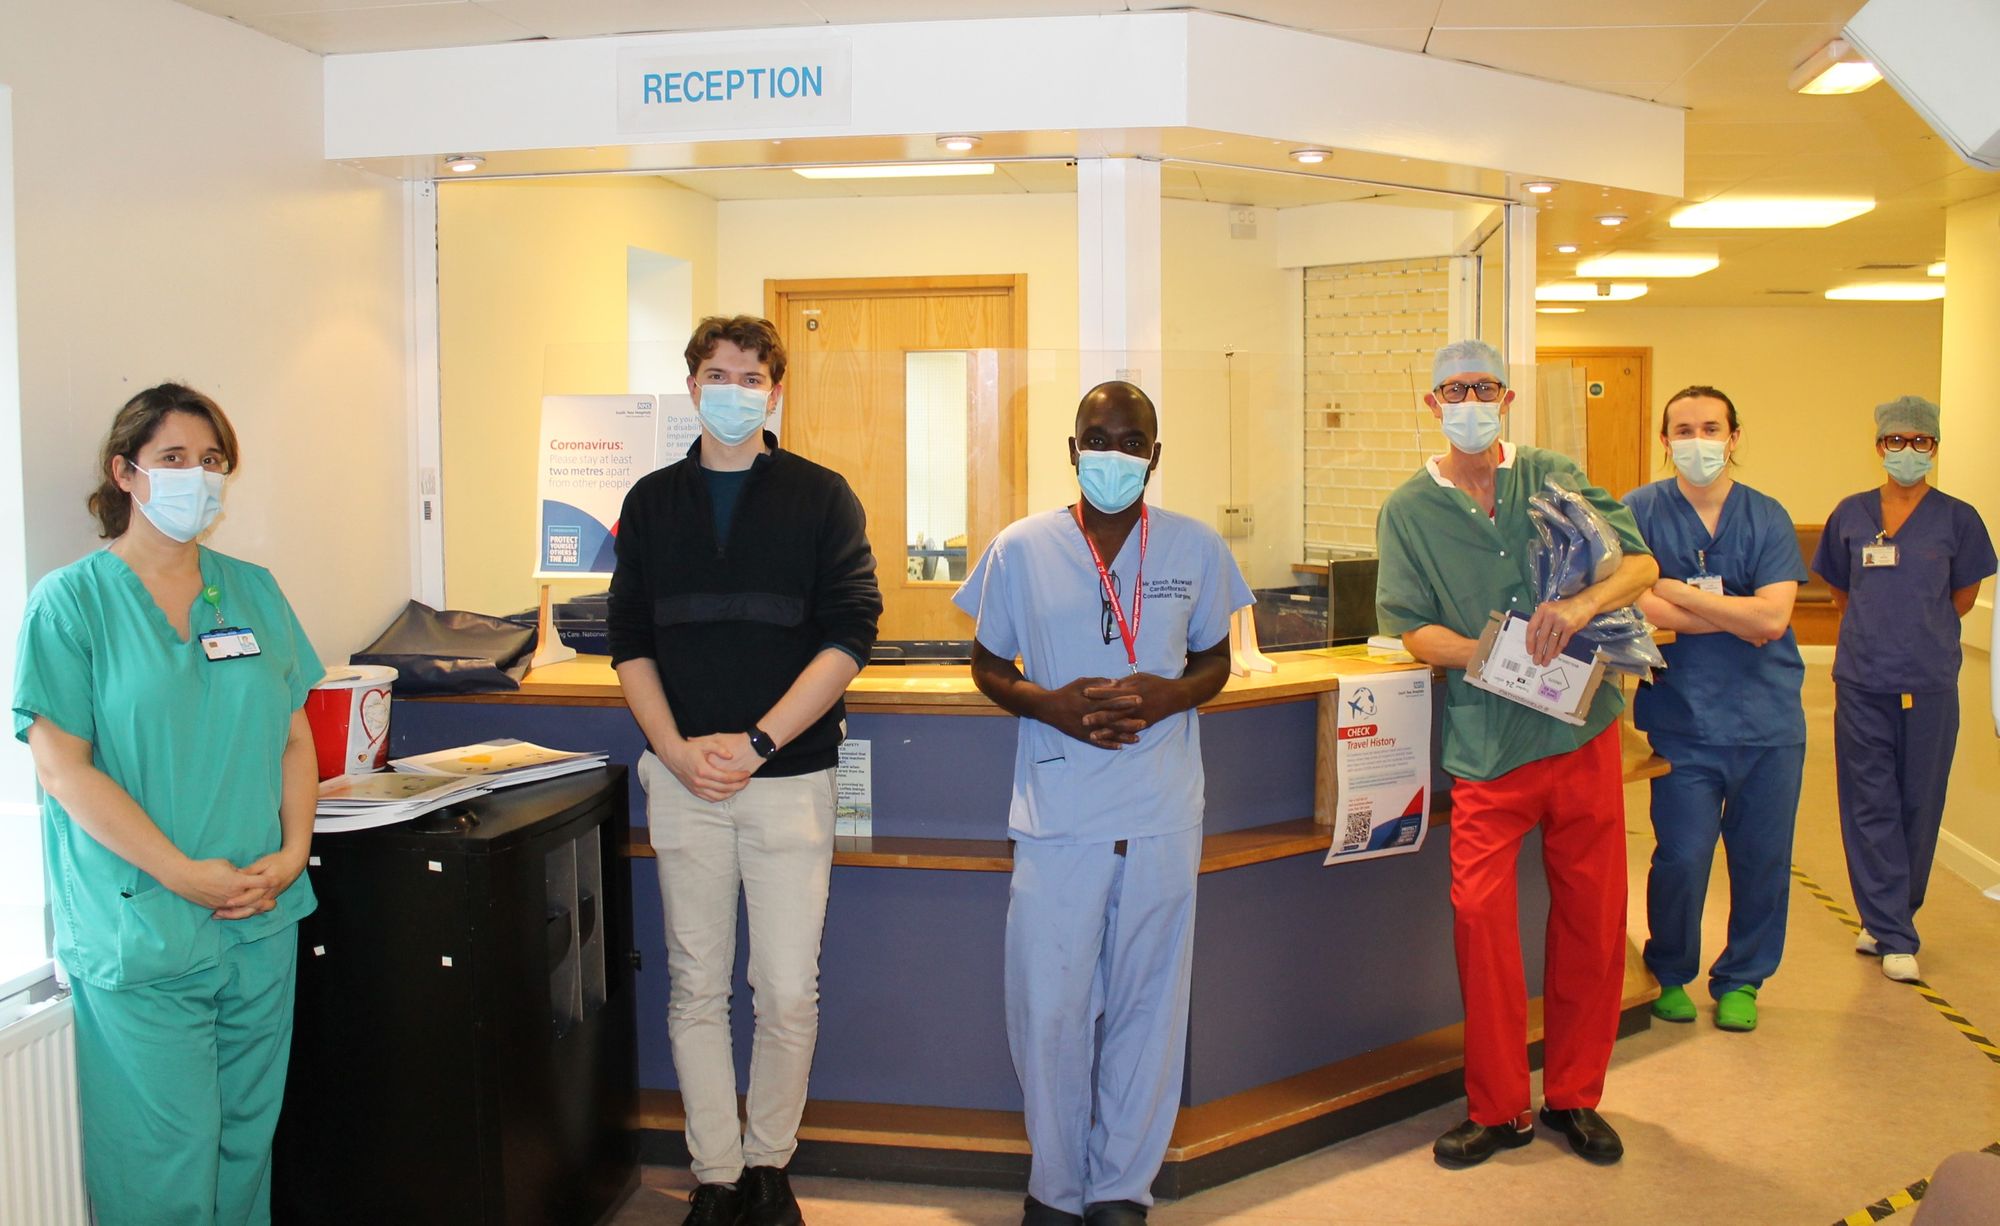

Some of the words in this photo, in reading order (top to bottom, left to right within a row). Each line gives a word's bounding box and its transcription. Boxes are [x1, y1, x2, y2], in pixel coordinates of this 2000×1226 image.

[644, 66, 822, 104] RECEPTION
[550, 439, 624, 450] Coronavirus:
[550, 455, 578, 464] Please
[579, 456, 598, 466] stay
[600, 456, 609, 464] at
[610, 455, 632, 464] least
[550, 468, 569, 476] two
[570, 468, 604, 476] metres
[606, 468, 630, 478] apart
[549, 478, 570, 487] from
[572, 479, 597, 488] other
[600, 480, 630, 490] people
[1347, 727, 1370, 737] CHECK
[1348, 740, 1368, 750] Travel
[1371, 738, 1396, 747] History
